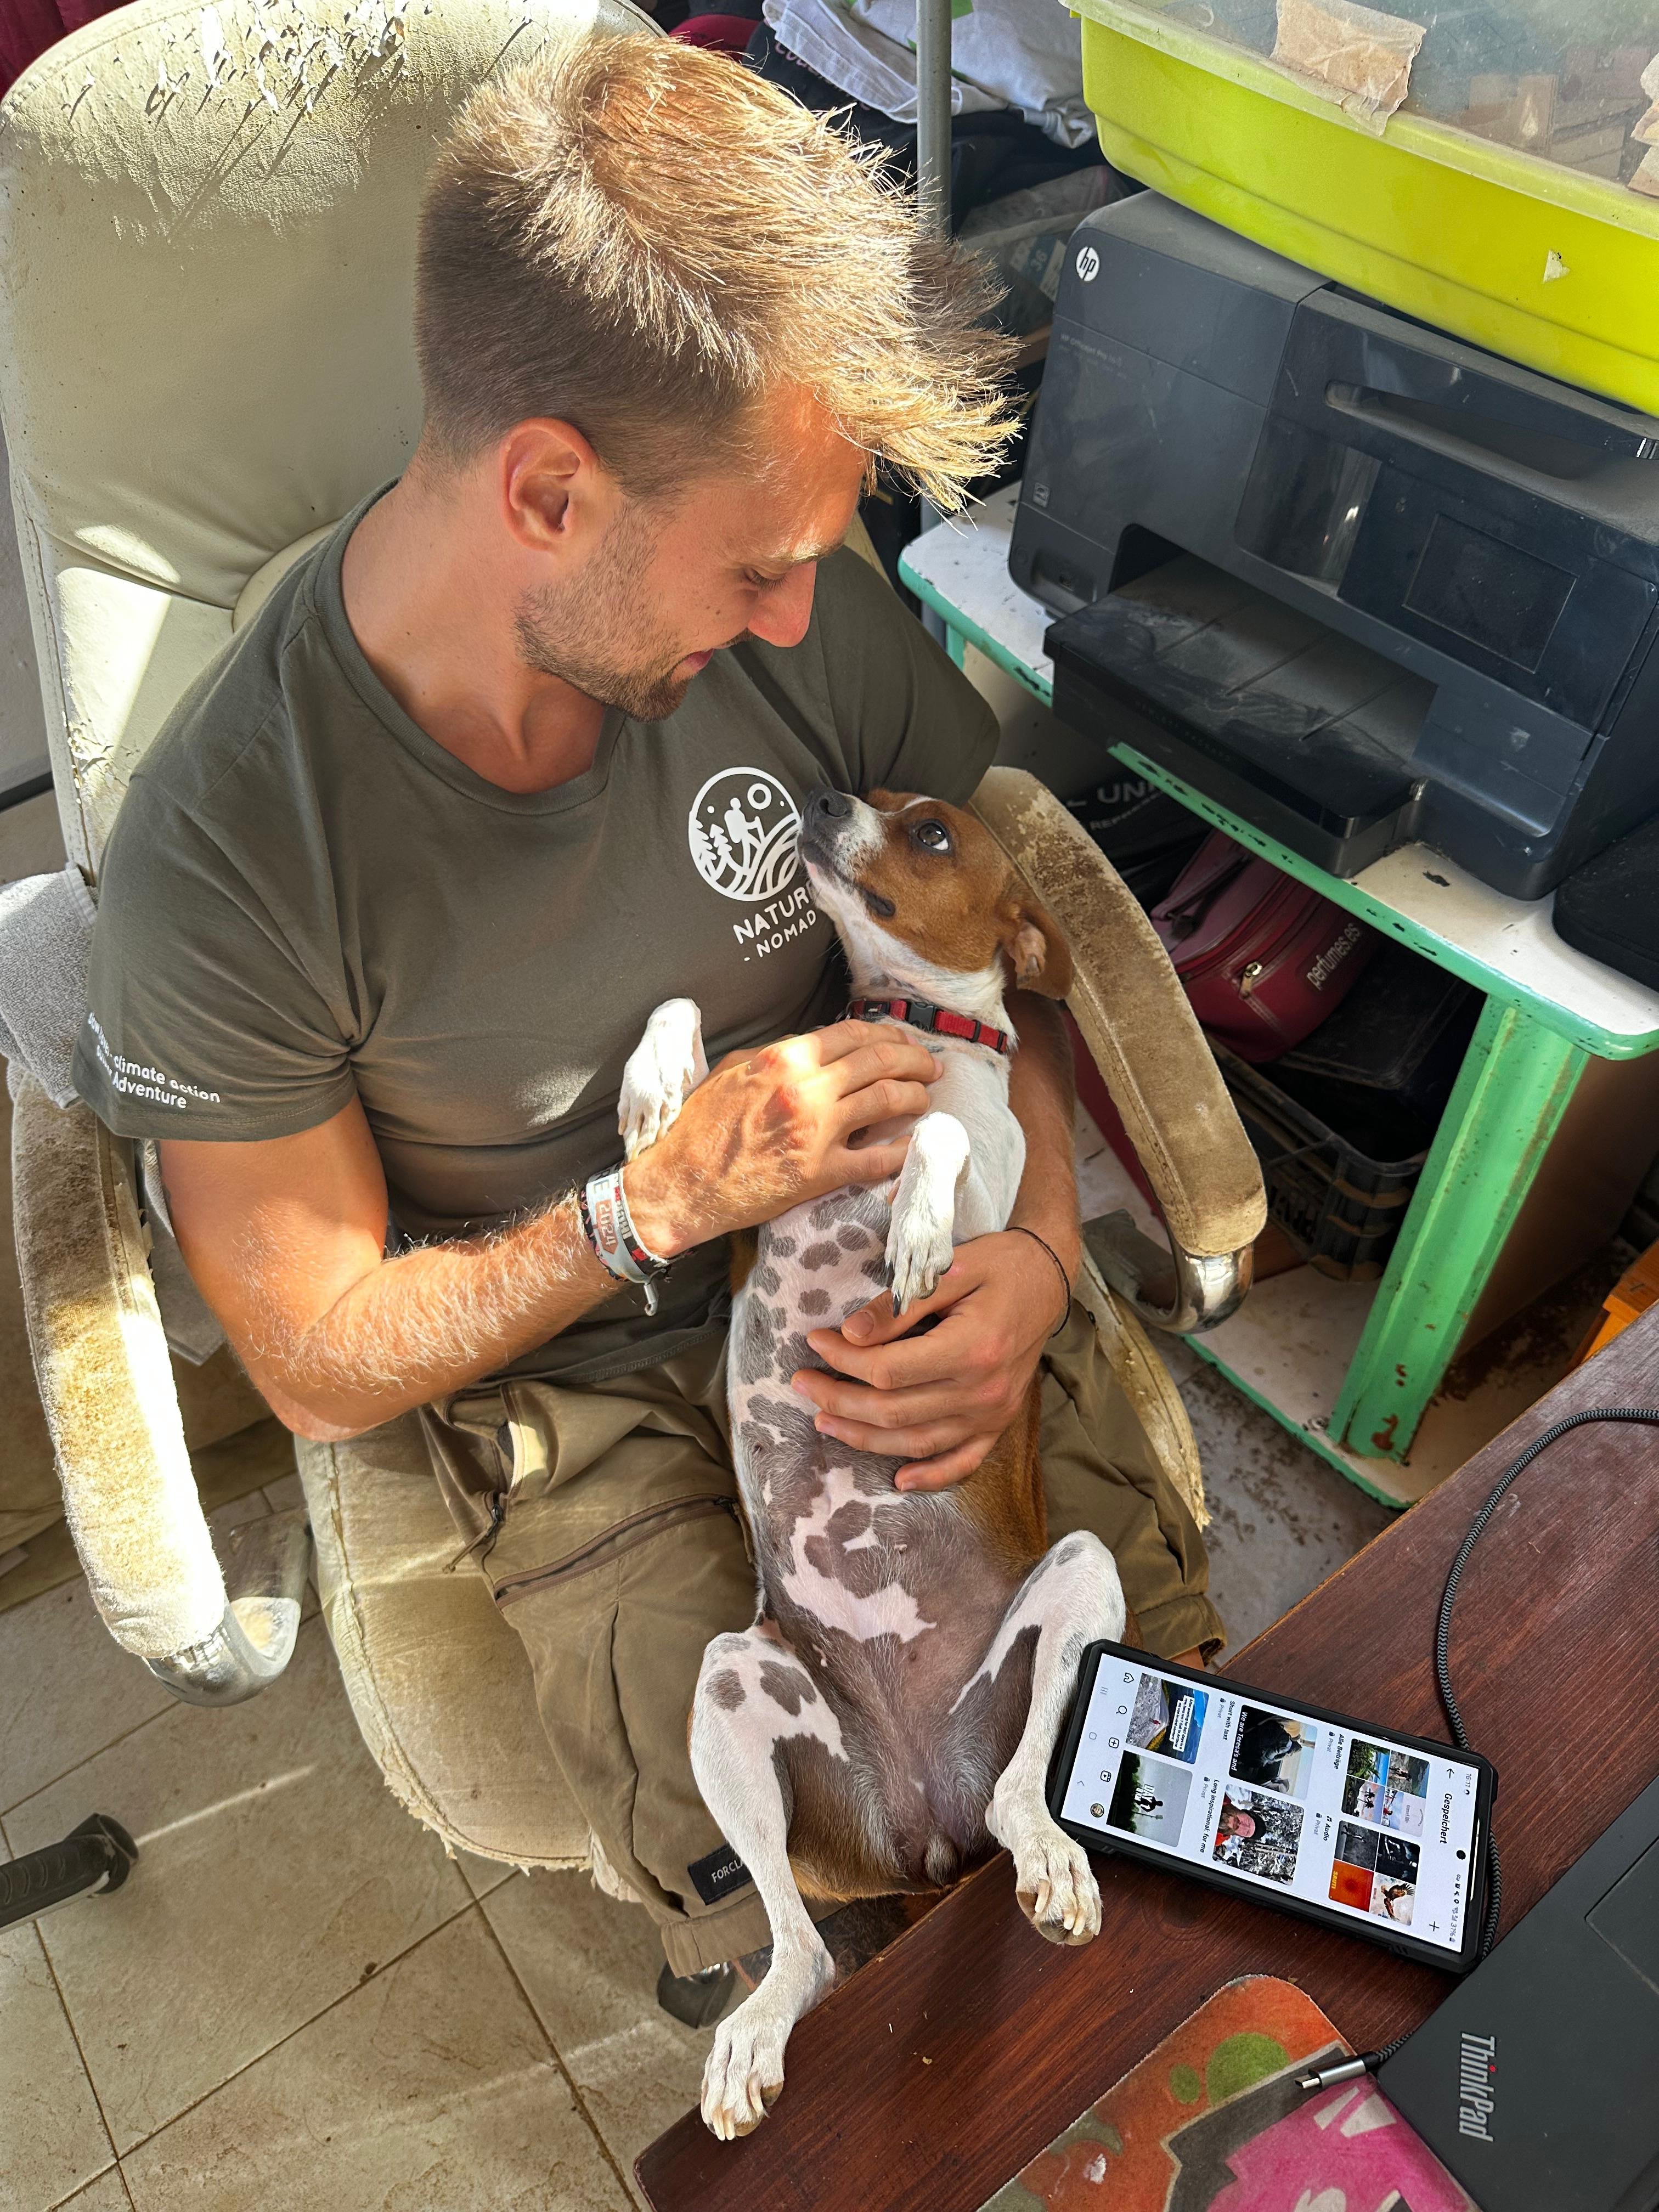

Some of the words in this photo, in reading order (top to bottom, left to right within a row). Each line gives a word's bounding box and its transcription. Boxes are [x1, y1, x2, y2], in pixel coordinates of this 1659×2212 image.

[1077, 246, 1098, 281] hp
[733, 885, 811, 944] NATUR
[756, 910, 817, 957] NOMAD
[1306, 922, 1360, 991] perfumes.es
[112, 1073, 188, 1109] Adventure
[114, 1056, 166, 1085] climate
[170, 1079, 221, 1103] action
[599, 1203, 617, 1247] 2024
[1227, 1700, 1235, 1716] Short
[1240, 1711, 1247, 1721] We
[1233, 1733, 1243, 1758] Teresa's
[1332, 1746, 1343, 1770] Beiträge
[1231, 1758, 1239, 1770] and
[1133, 1792, 1142, 1801] KM
[1141, 1784, 1155, 1802] DAY
[1211, 1779, 1219, 1794] Long
[1439, 1793, 1452, 1844] Gespeichert
[1323, 1823, 1331, 1841] Audio
[1200, 1843, 1205, 1853] me
[1459, 2032, 1496, 2142] ThinkPad
